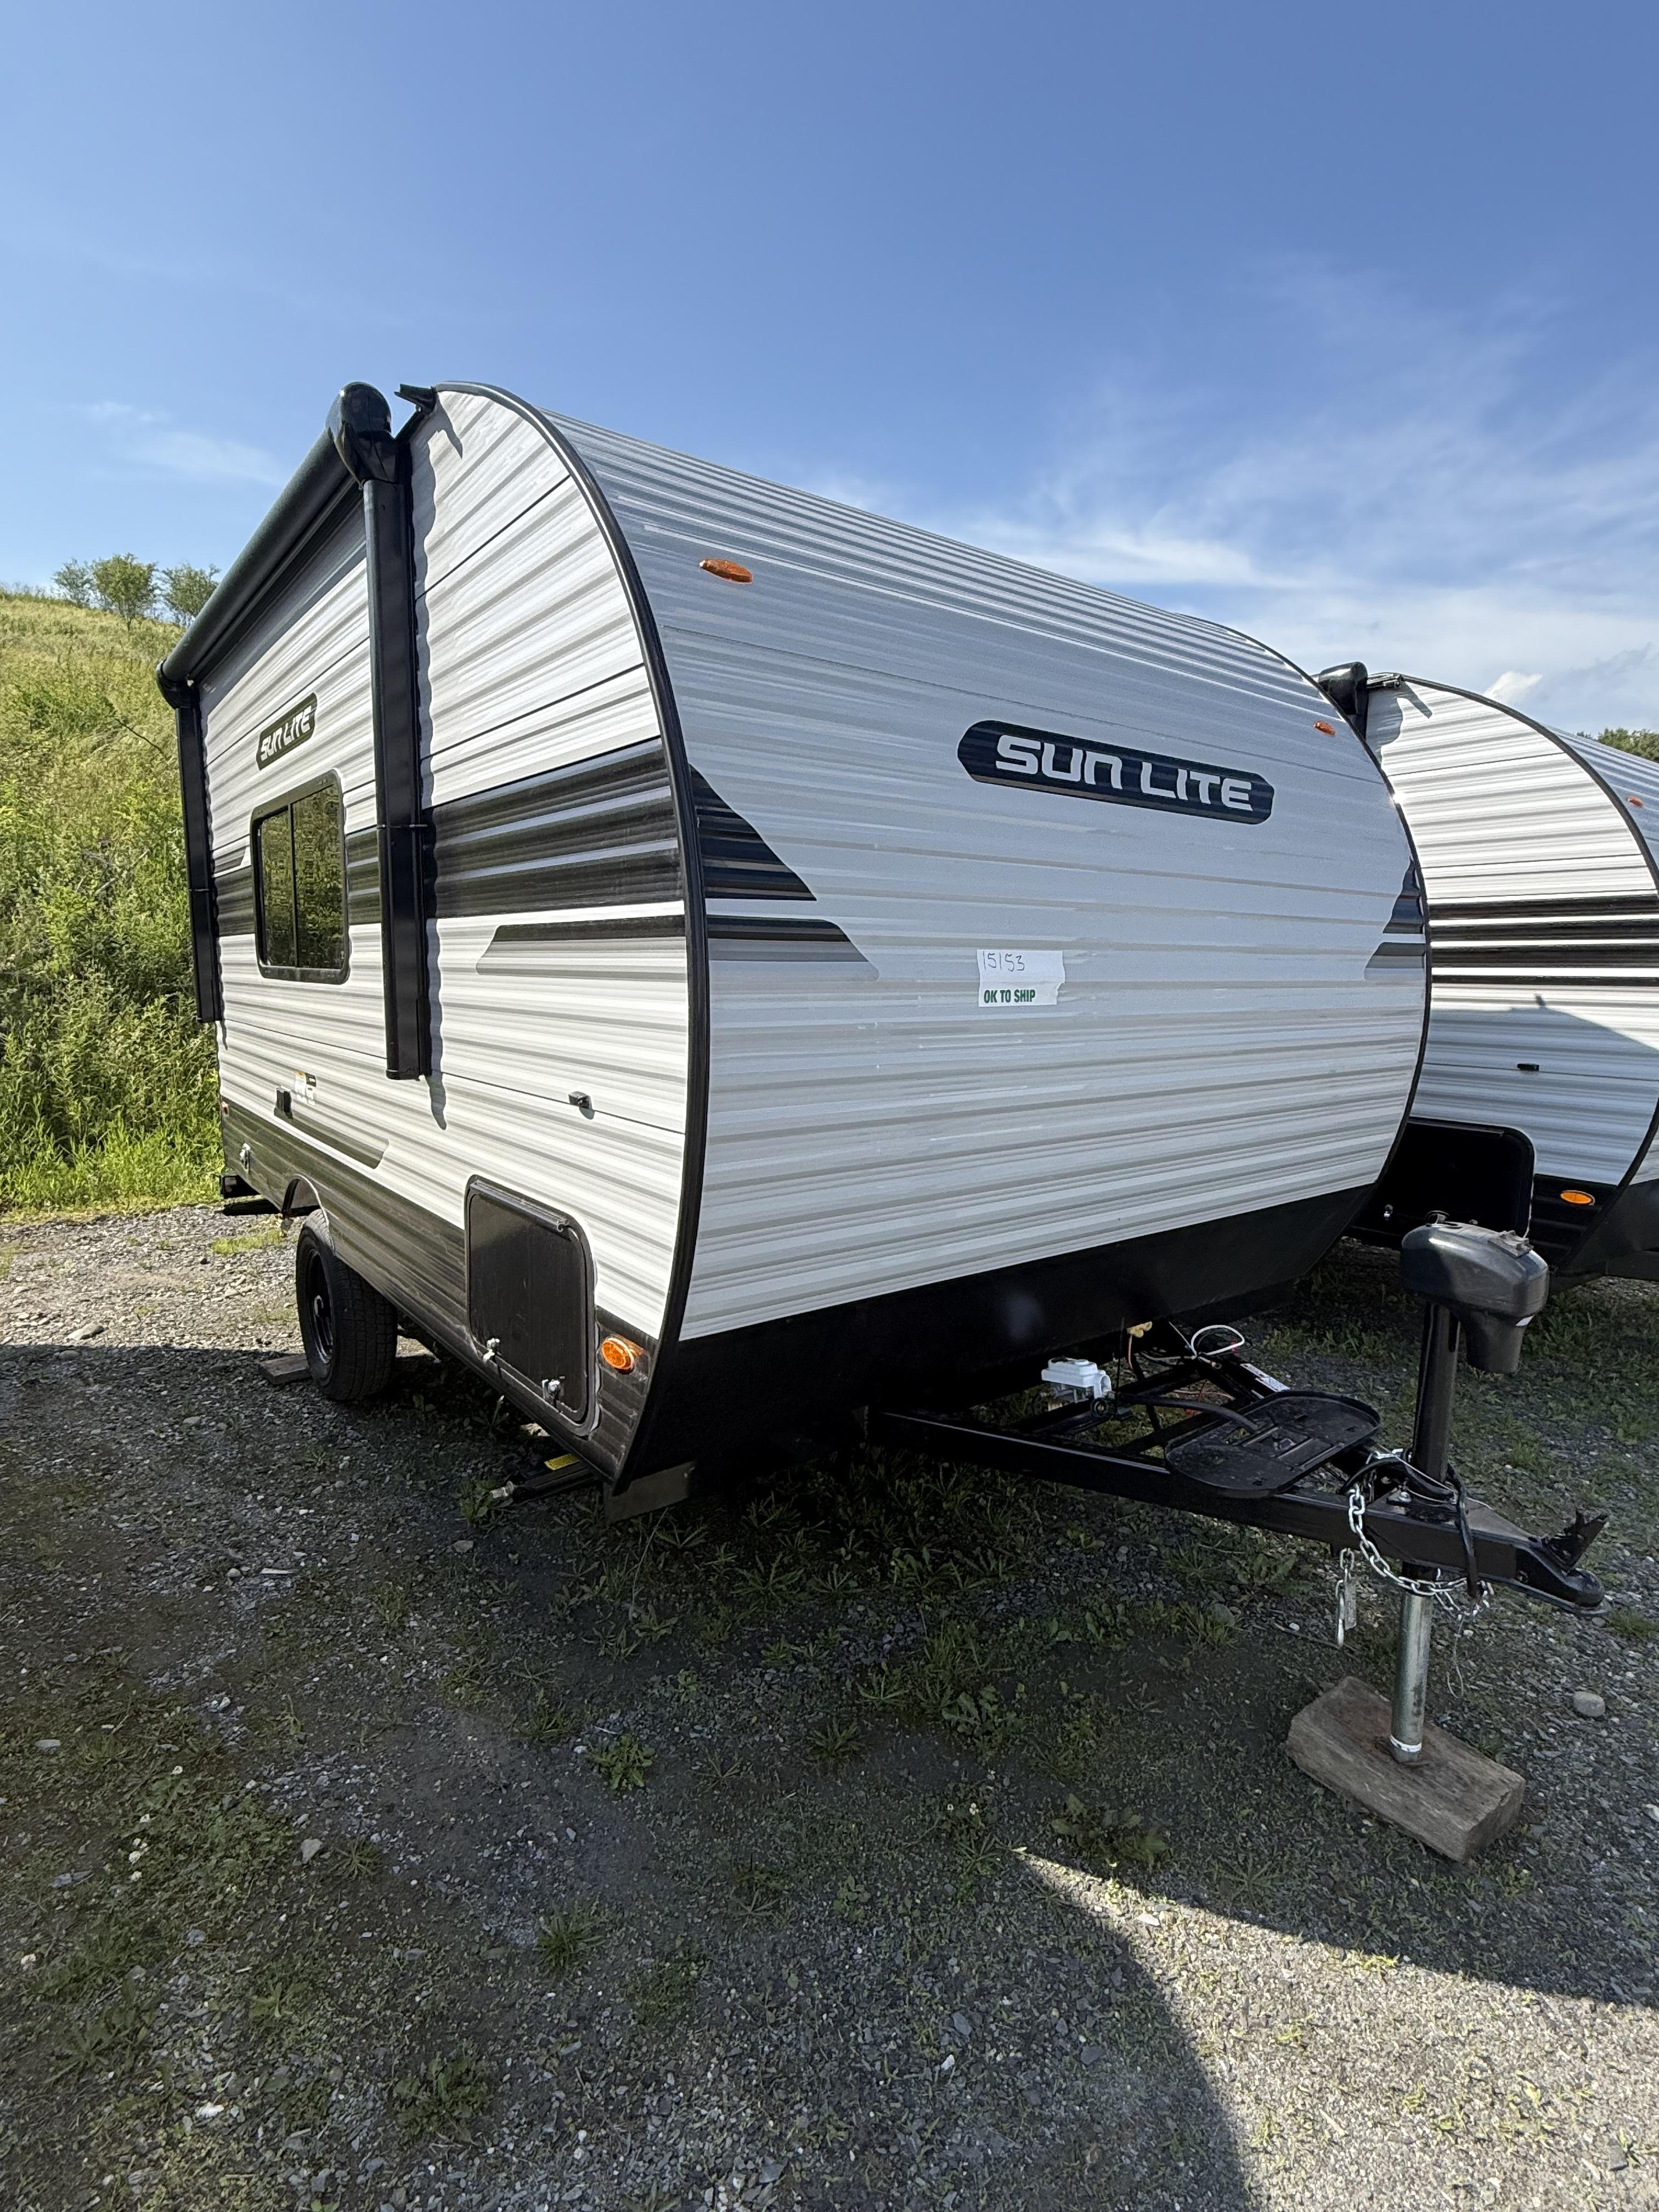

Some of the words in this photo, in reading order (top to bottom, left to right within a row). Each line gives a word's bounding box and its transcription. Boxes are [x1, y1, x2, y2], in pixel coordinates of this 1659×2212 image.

[260, 727, 283, 761] SUN
[283, 706, 312, 746] LITE
[995, 735, 1123, 790] SUN
[1140, 761, 1253, 812] LITE
[983, 951, 1025, 972] 15153
[984, 990, 997, 1003] OK
[1000, 990, 1011, 1003] TO
[1014, 989, 1036, 1003] SHIP
